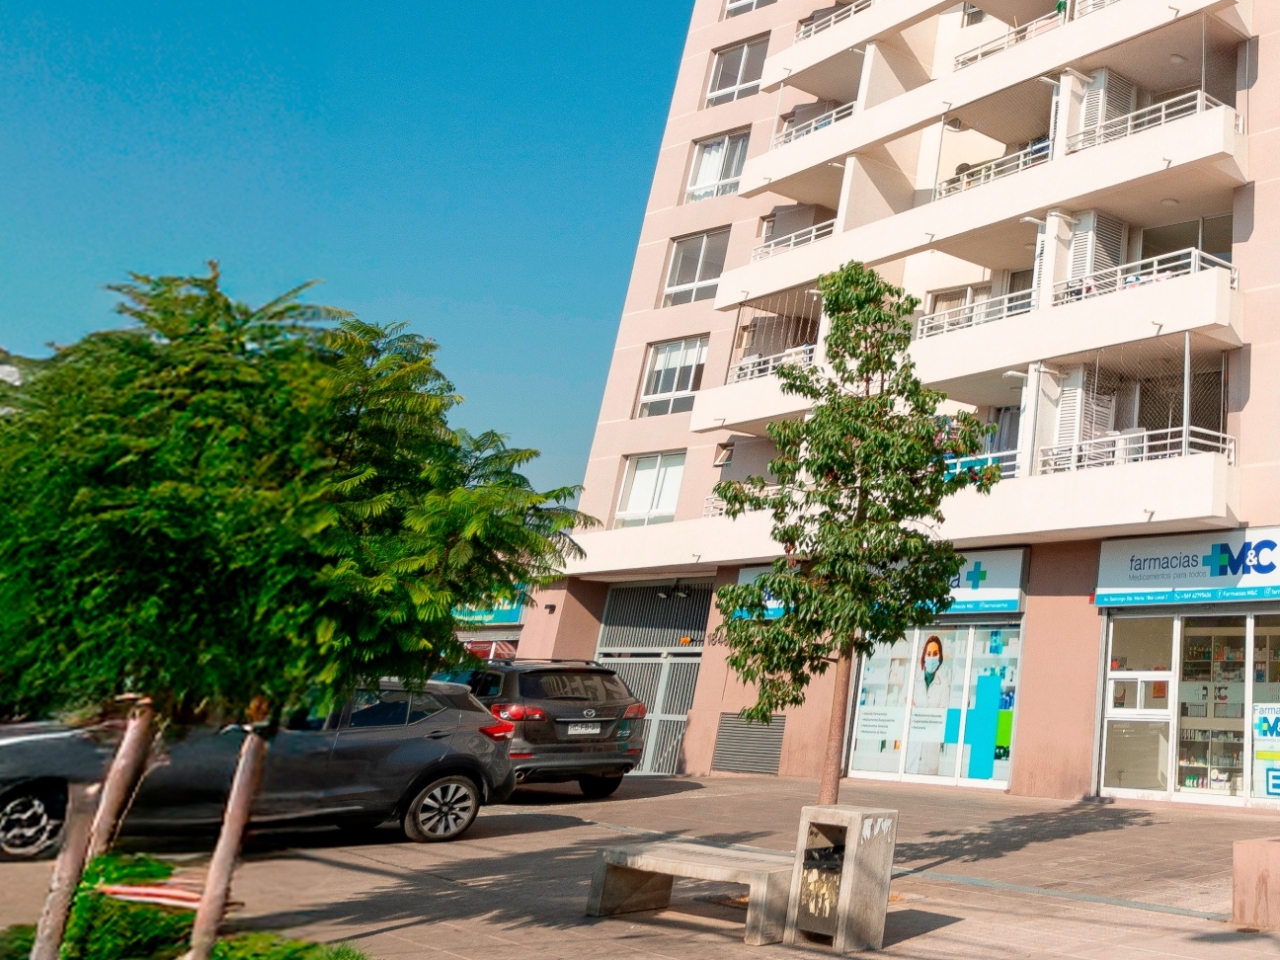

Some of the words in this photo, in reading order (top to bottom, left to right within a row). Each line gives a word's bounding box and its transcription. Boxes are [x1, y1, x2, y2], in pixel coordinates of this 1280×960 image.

[1129, 551, 1199, 571] farmacias
[1219, 539, 1277, 576] M&C
[1128, 573, 1171, 582] Medicamentos
[1188, 570, 1207, 579] todos
